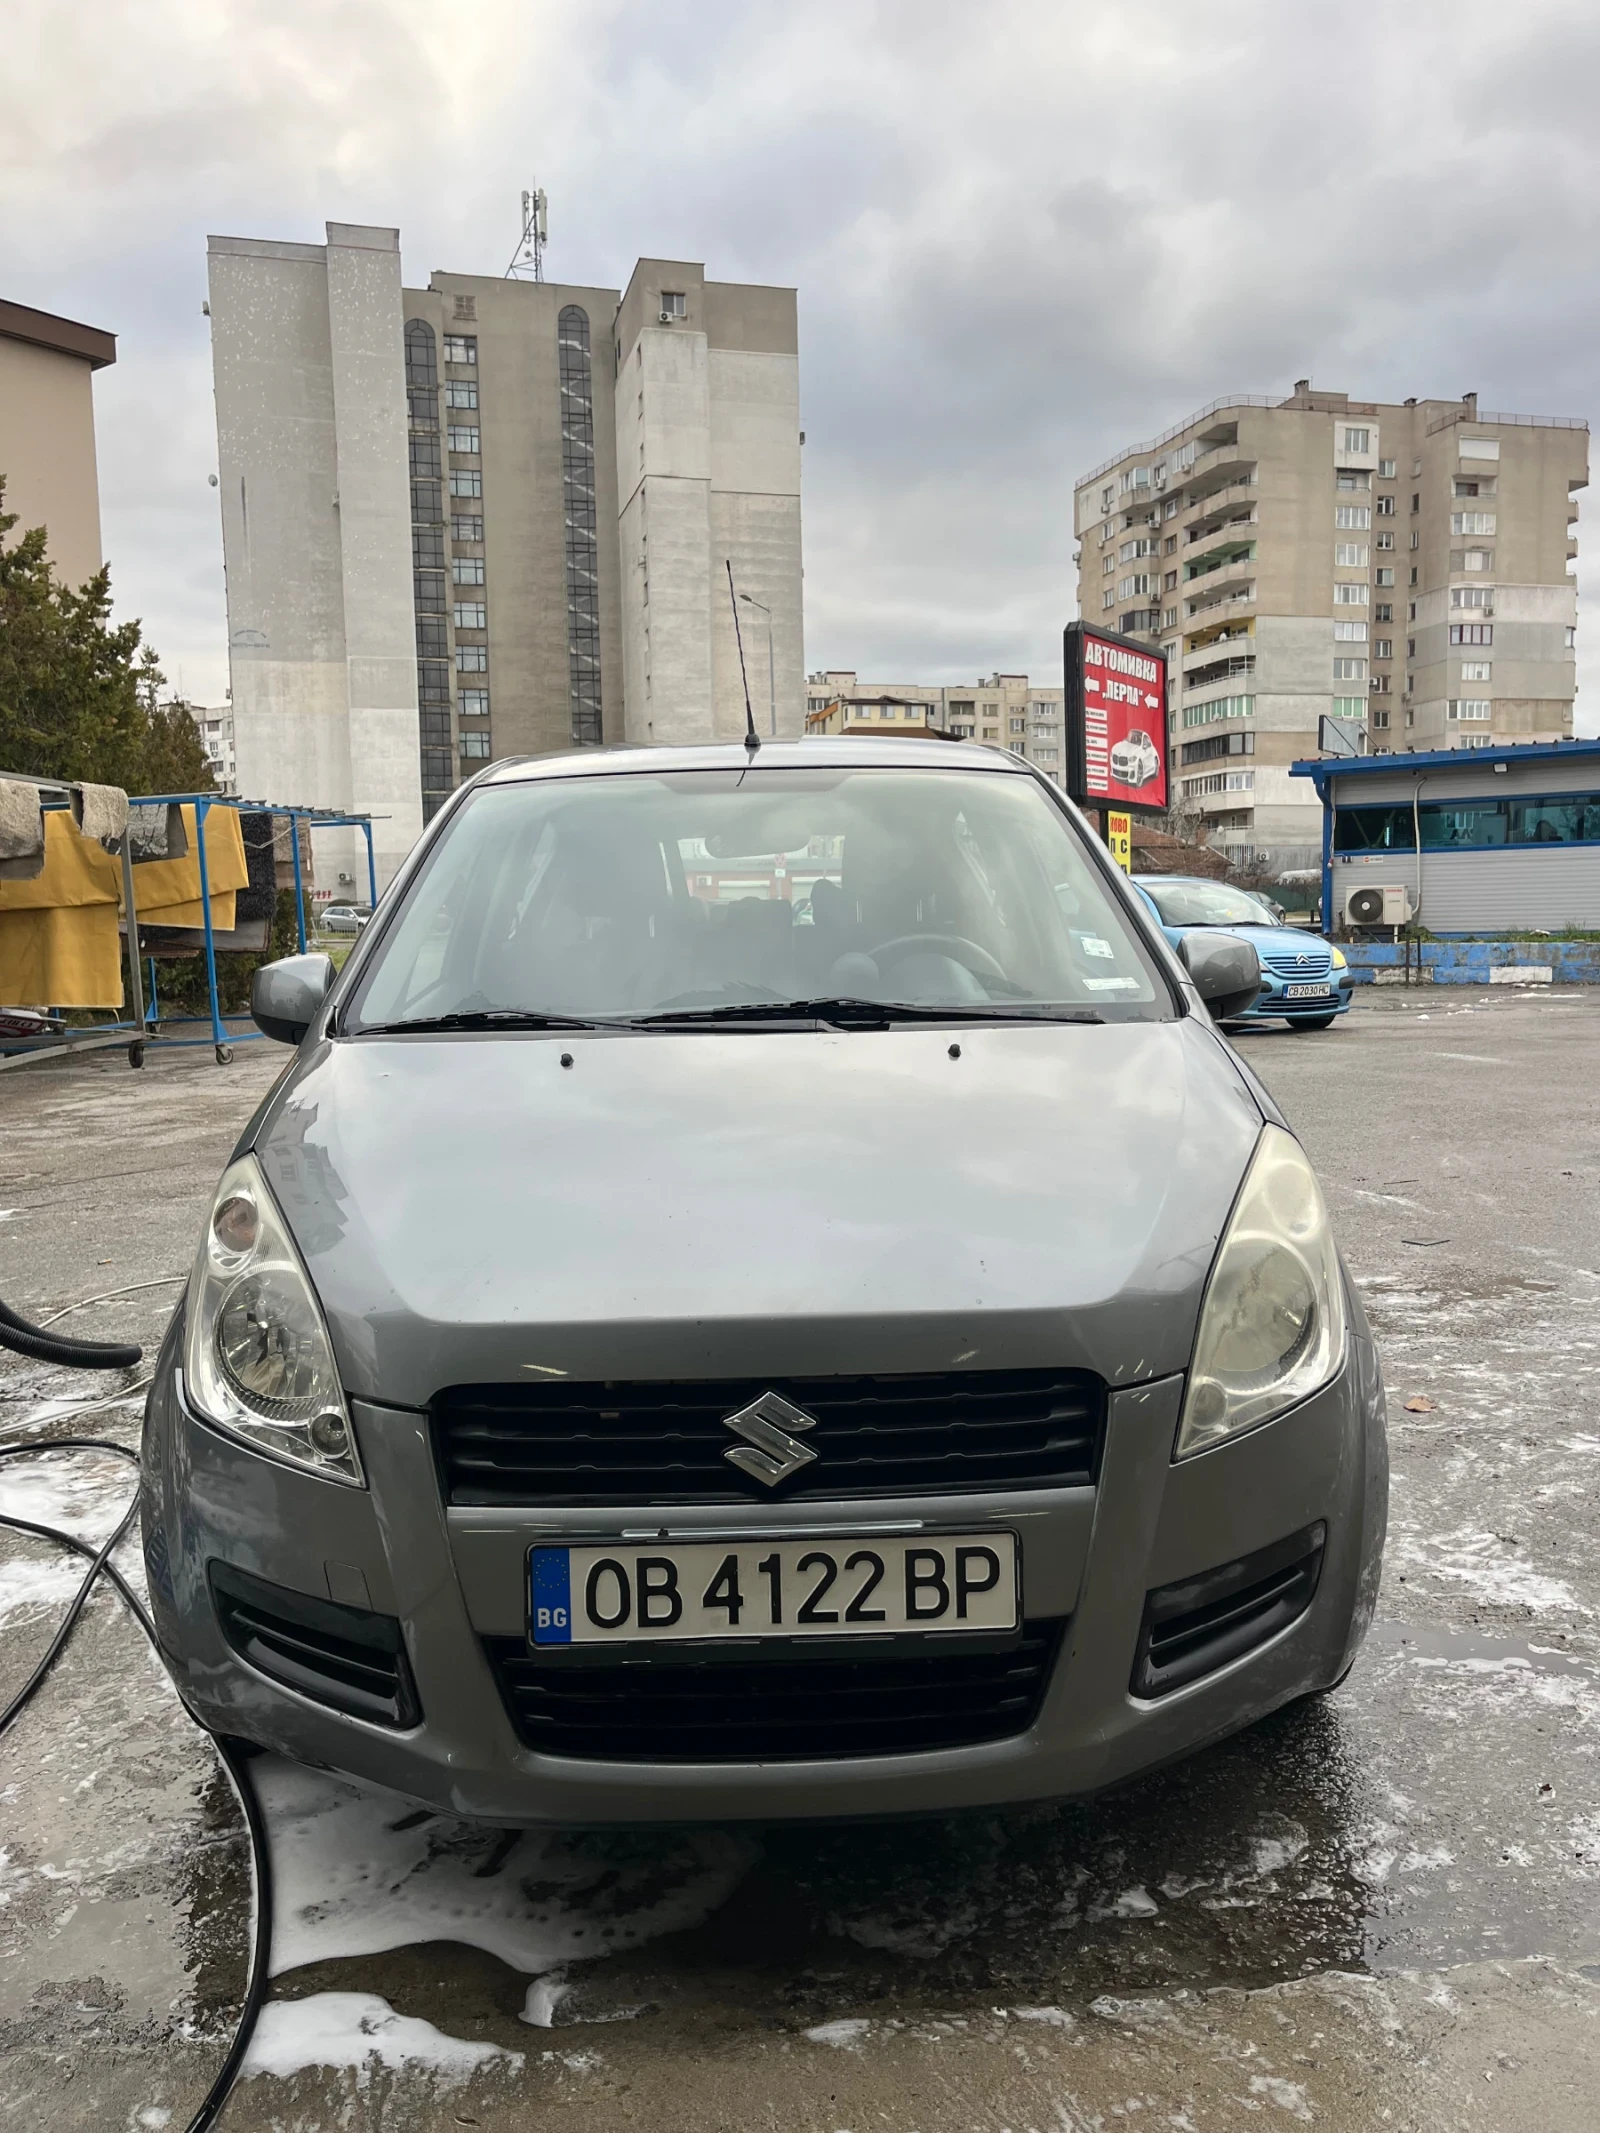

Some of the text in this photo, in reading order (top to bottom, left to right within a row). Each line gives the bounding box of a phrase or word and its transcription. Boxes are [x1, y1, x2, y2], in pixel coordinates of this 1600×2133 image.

[1085, 641, 1157, 683] АВТОМИВКА
[1299, 985, 1318, 996] 2030
[585, 1546, 1000, 1629] OB 4122 BP
[537, 1607, 567, 1628] BG
